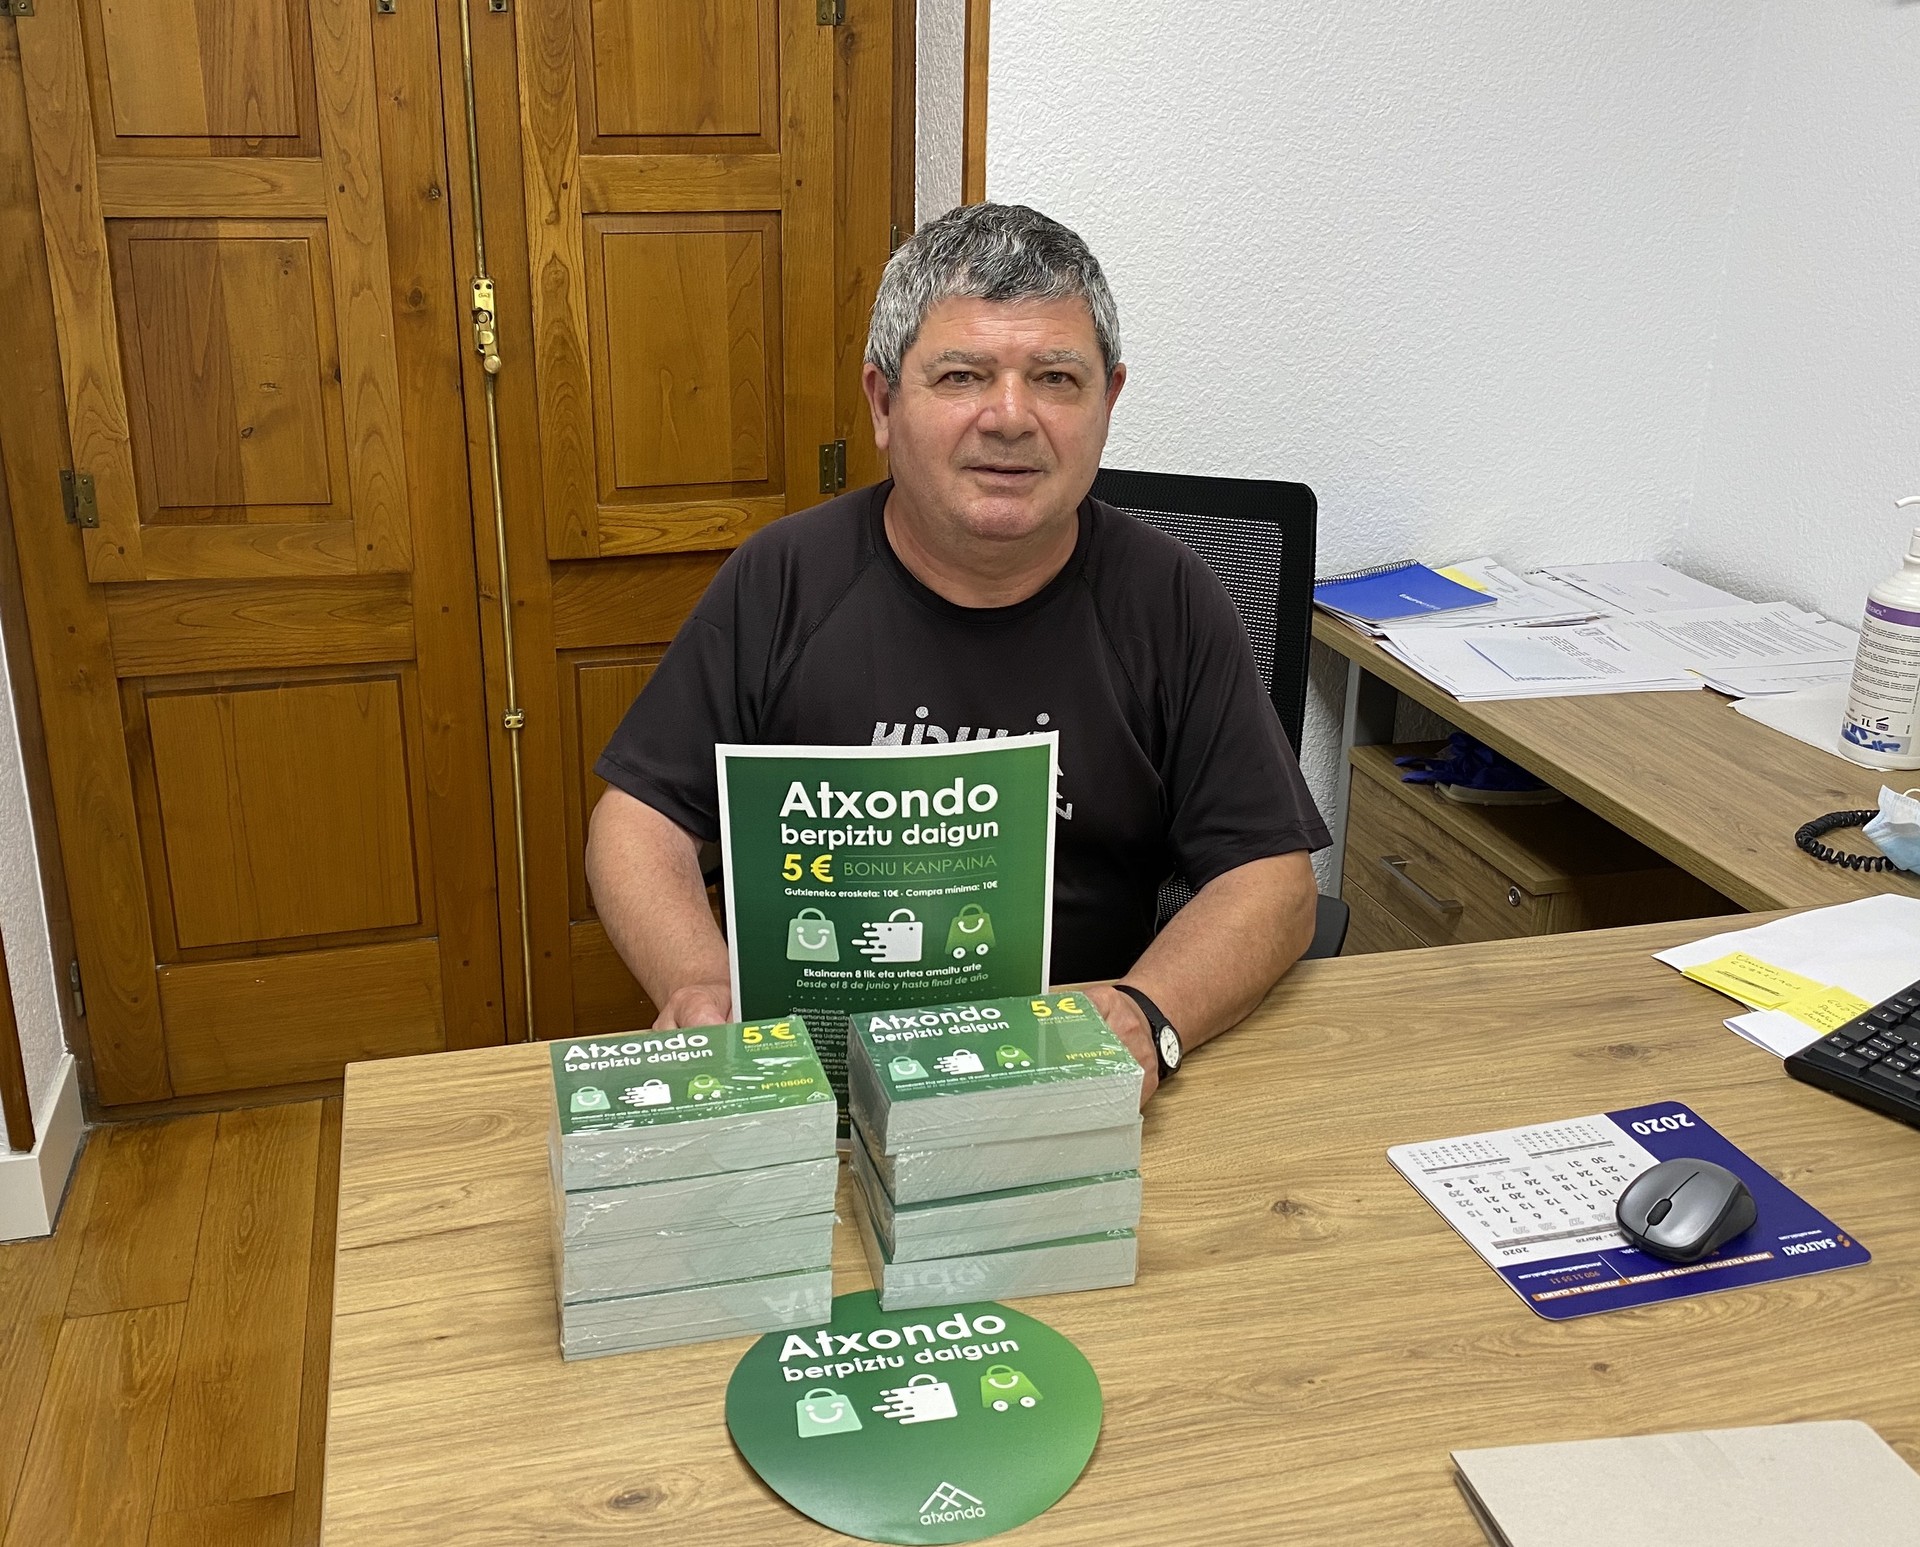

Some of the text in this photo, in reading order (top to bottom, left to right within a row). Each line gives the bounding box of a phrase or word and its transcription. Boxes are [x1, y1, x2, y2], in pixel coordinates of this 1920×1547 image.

[779, 777, 999, 820] Atxondo
[780, 820, 999, 850] berpiztu daigun
[781, 853, 803, 882] 5
[844, 853, 997, 876] BONU KANPAINA
[784, 880, 998, 899] Gutxieneko erosketa: 10€ Compra mínima: 10€
[796, 972, 989, 991] Desde el 8 de junio y hasta final de año
[803, 968, 853, 979] Ekainaren
[854, 970, 862, 979] 8
[877, 969, 895, 979] eta
[897, 969, 924, 978] urtea
[925, 965, 959, 977] amaitu
[960, 962, 982, 974] arte
[868, 1006, 1002, 1033] Atxondo
[1030, 1000, 1052, 1018] 5
[742, 1026, 763, 1044] 5
[871, 1020, 1010, 1044] berpiztu daigun
[563, 1032, 709, 1062] Atxondo
[564, 1048, 713, 1073] berpiztu daigun
[1631, 1112, 1696, 1136] 2020
[1567, 1156, 1607, 1168] 30 31
[1448, 1165, 1618, 1198] 23 24 25 26 27 28 29
[1535, 1188, 1551, 1196] 19
[1561, 1183, 1578, 1191] 18
[1456, 1200, 1474, 1208] 22
[1466, 1188, 1615, 1217] 10 11 12 13 14 15
[1508, 1192, 1525, 1200] 20
[1502, 1246, 1530, 1257] 2020
[1781, 1237, 1837, 1257] SALTOKI
[778, 1313, 1006, 1363] Atxondo
[782, 1338, 1020, 1382] berpiztu daigun
[920, 1505, 986, 1526] atxondo
